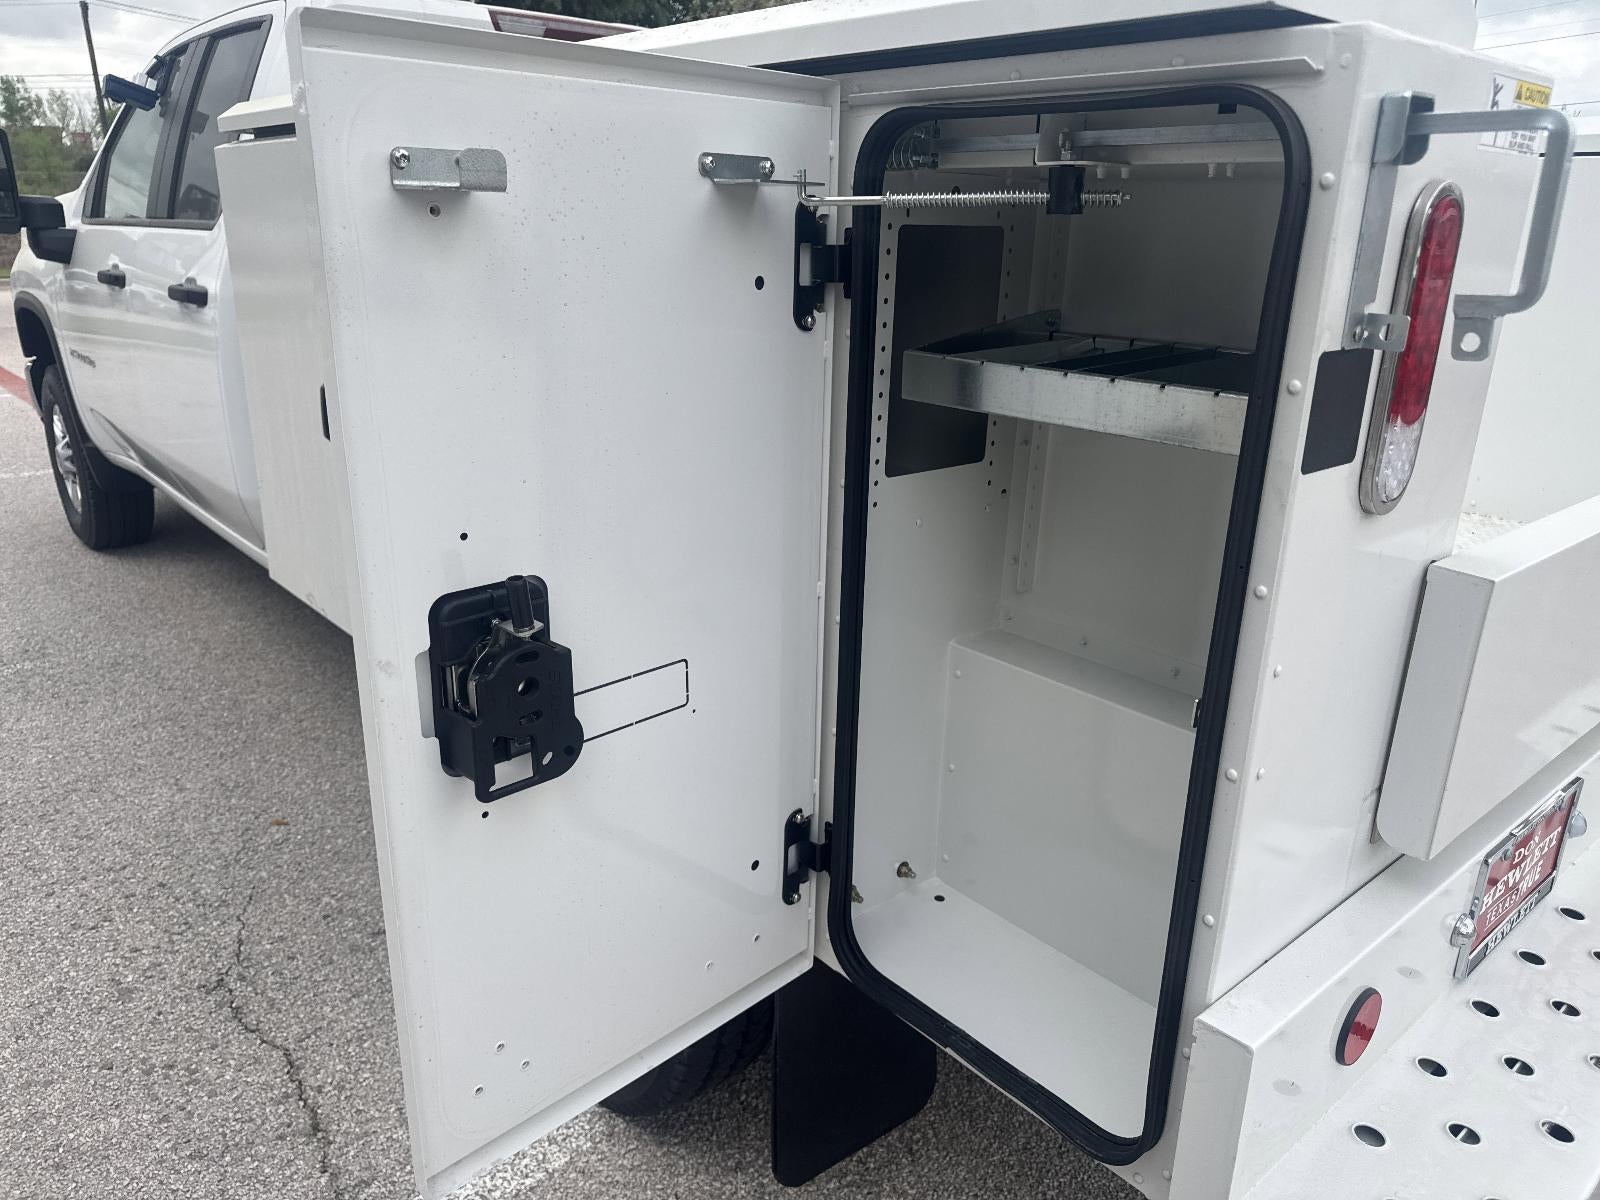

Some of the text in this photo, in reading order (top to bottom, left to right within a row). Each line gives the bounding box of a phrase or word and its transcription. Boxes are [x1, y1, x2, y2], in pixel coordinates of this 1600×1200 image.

[1524, 86, 1551, 106] CAUTION
[1480, 826, 1561, 915] HEWLETT
[1513, 831, 1541, 865] DON
[1486, 895, 1540, 955] HEWLETT
